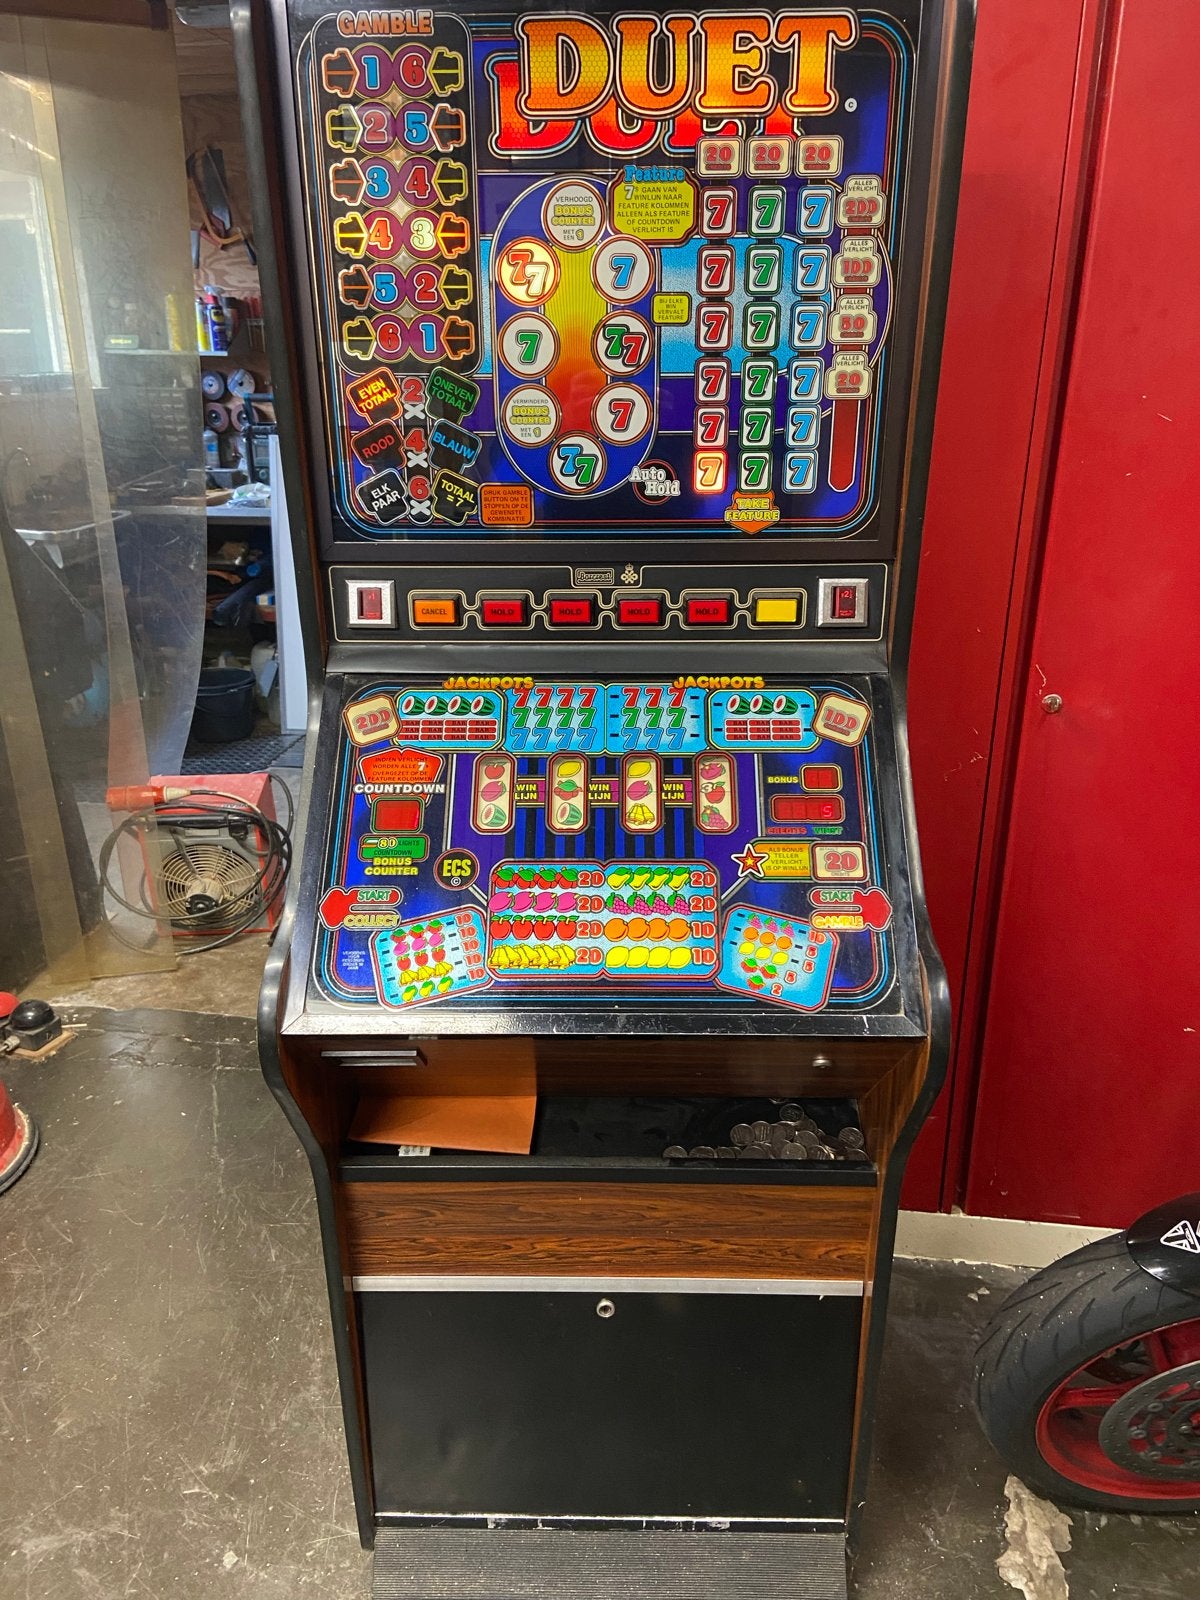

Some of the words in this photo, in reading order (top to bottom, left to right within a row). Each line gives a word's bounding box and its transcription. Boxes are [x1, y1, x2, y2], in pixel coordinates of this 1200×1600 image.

[337, 9, 433, 38] GAMBLE
[362, 55, 379, 90] 1
[400, 53, 426, 88] 6
[514, 9, 859, 117] DUET
[362, 110, 387, 144] 2
[405, 111, 429, 144] 5
[703, 143, 735, 165] 20
[752, 143, 784, 165] 20
[802, 143, 833, 165] 20
[623, 165, 685, 183] Feature
[366, 166, 391, 200] 3
[405, 166, 430, 198] 4
[642, 186, 661, 194] GAAN
[554, 204, 594, 217] BONUS
[707, 194, 731, 229] 7
[756, 194, 780, 229] 7
[804, 194, 829, 229] 7
[551, 216, 595, 226] COUNTER
[368, 217, 393, 250] 4
[410, 217, 436, 251] 3
[609, 253, 637, 290] 7
[373, 272, 398, 304] 5
[414, 271, 438, 303] 2
[839, 314, 866, 333] 50
[377, 321, 401, 353] 6
[419, 322, 437, 353] 1
[516, 330, 542, 365] 7
[836, 370, 863, 388] 20
[358, 378, 386, 401] EVEN
[401, 376, 426, 404] 2
[433, 376, 474, 402] ONEVEN
[359, 388, 396, 412] TOTAAL
[431, 386, 467, 412] TOTAAL
[512, 406, 549, 417] BONUS
[609, 398, 635, 433] 7
[362, 434, 395, 459] ROOD
[404, 428, 427, 453] 4
[432, 431, 476, 459] BLAUW
[629, 465, 666, 482] Auto
[699, 457, 722, 486] 7
[371, 482, 391, 499] ELK
[408, 475, 431, 500] 6
[440, 478, 475, 504] TOTAAL
[645, 480, 680, 496] Hold
[371, 489, 401, 512] PAAR
[454, 496, 465, 507] 7
[736, 498, 769, 509] TAKE
[724, 510, 780, 521] FEATURE
[421, 608, 448, 616] CANCEL
[491, 608, 514, 616] HOLD
[559, 608, 582, 616] HOLD
[627, 608, 650, 616] HOLD
[696, 608, 719, 616] HOLD
[442, 676, 535, 690] JACKPOTS
[673, 676, 765, 689] JACKPOTS
[353, 783, 445, 794] COUNTDOWN
[768, 776, 798, 784] BONUS
[514, 792, 537, 800] LIJN
[588, 792, 611, 800] LIJN
[662, 791, 684, 800] LIJN
[373, 857, 412, 866] BONUS
[442, 859, 472, 877] ECS
[825, 851, 858, 872] 20
[364, 866, 418, 875] COUNTER
[577, 871, 605, 888] 20
[690, 871, 717, 888] 20
[357, 890, 391, 901] START
[820, 890, 854, 902] START
[343, 914, 400, 927] COLLECT
[691, 921, 717, 937] 10
[813, 915, 864, 928] GAMBLE
[691, 947, 717, 964] 10
[468, 967, 486, 981] 10
[771, 982, 783, 997] 2
